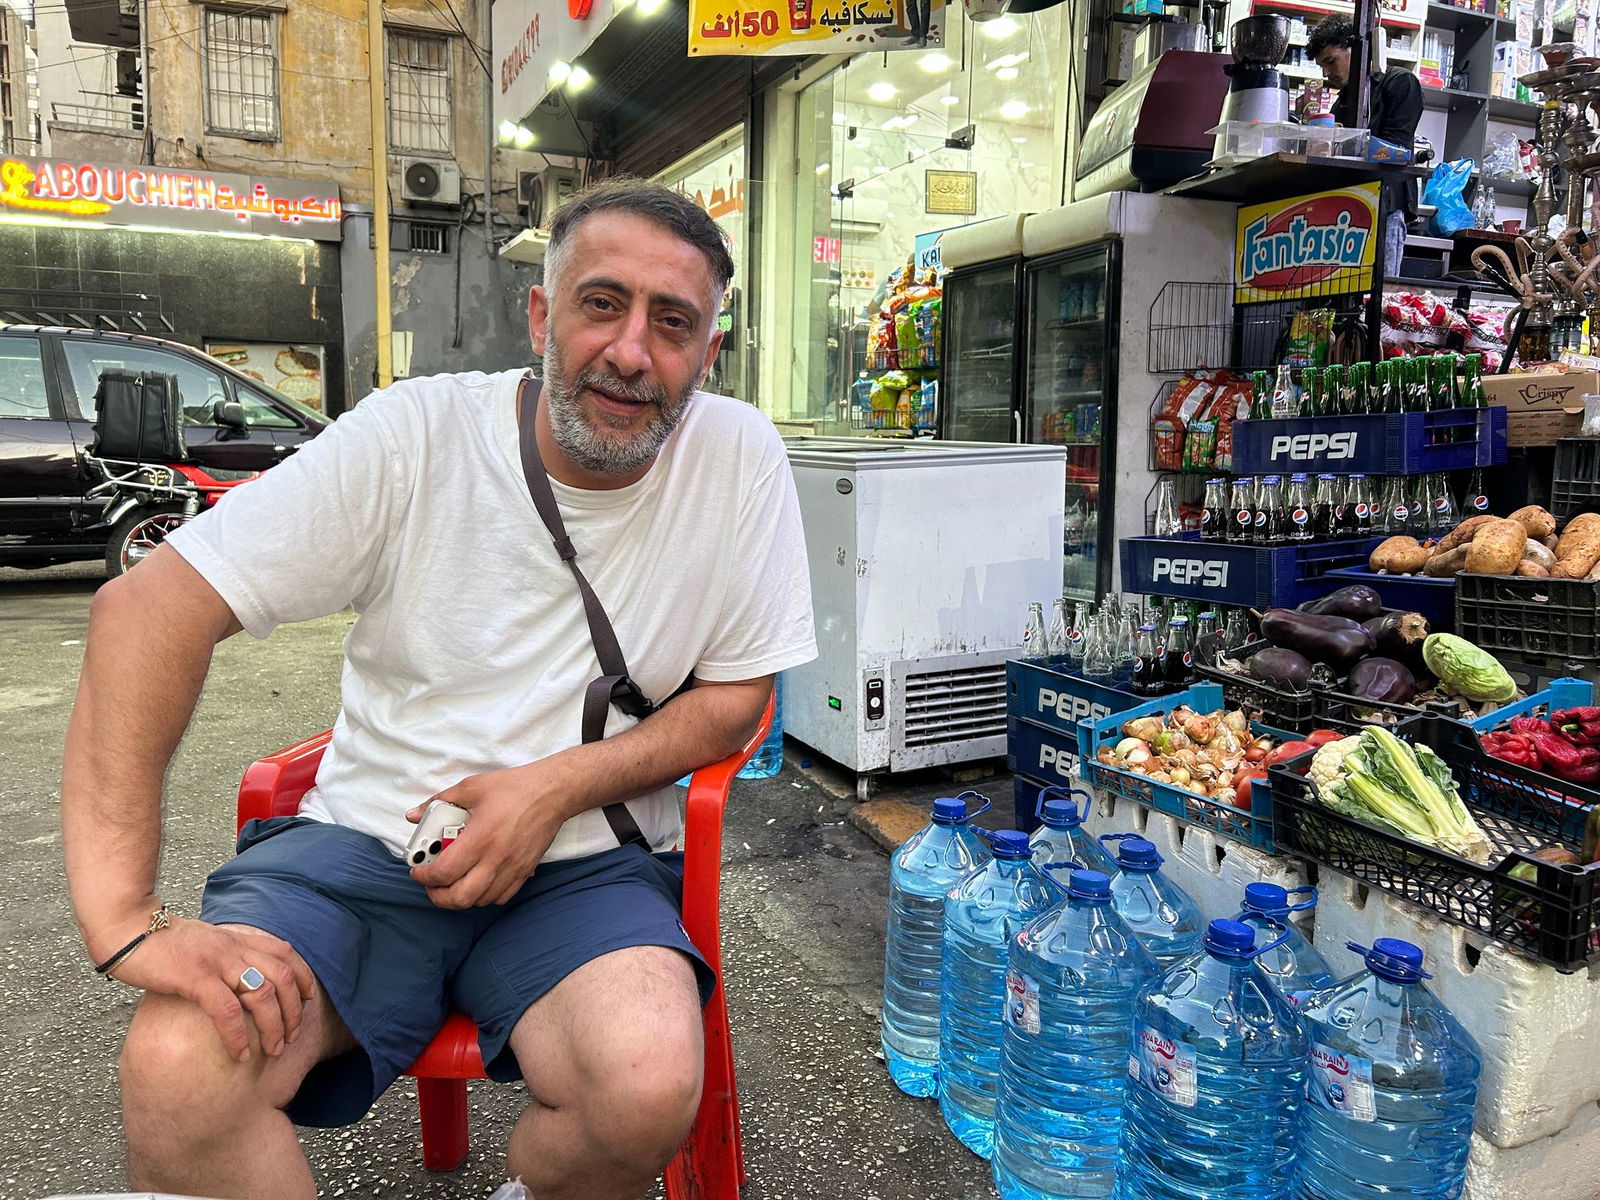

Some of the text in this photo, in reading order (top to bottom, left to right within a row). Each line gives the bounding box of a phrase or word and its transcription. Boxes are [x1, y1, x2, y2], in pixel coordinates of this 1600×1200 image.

[820, 1, 894, 33] نسكافيه
[34, 162, 214, 210] ABOUCHIEH
[216, 184, 342, 220] الكبوشية
[1243, 212, 1367, 282] Fantasia
[1525, 384, 1565, 405] Crispy
[1270, 432, 1358, 461] PEPSI
[1152, 558, 1229, 588] PEPSI
